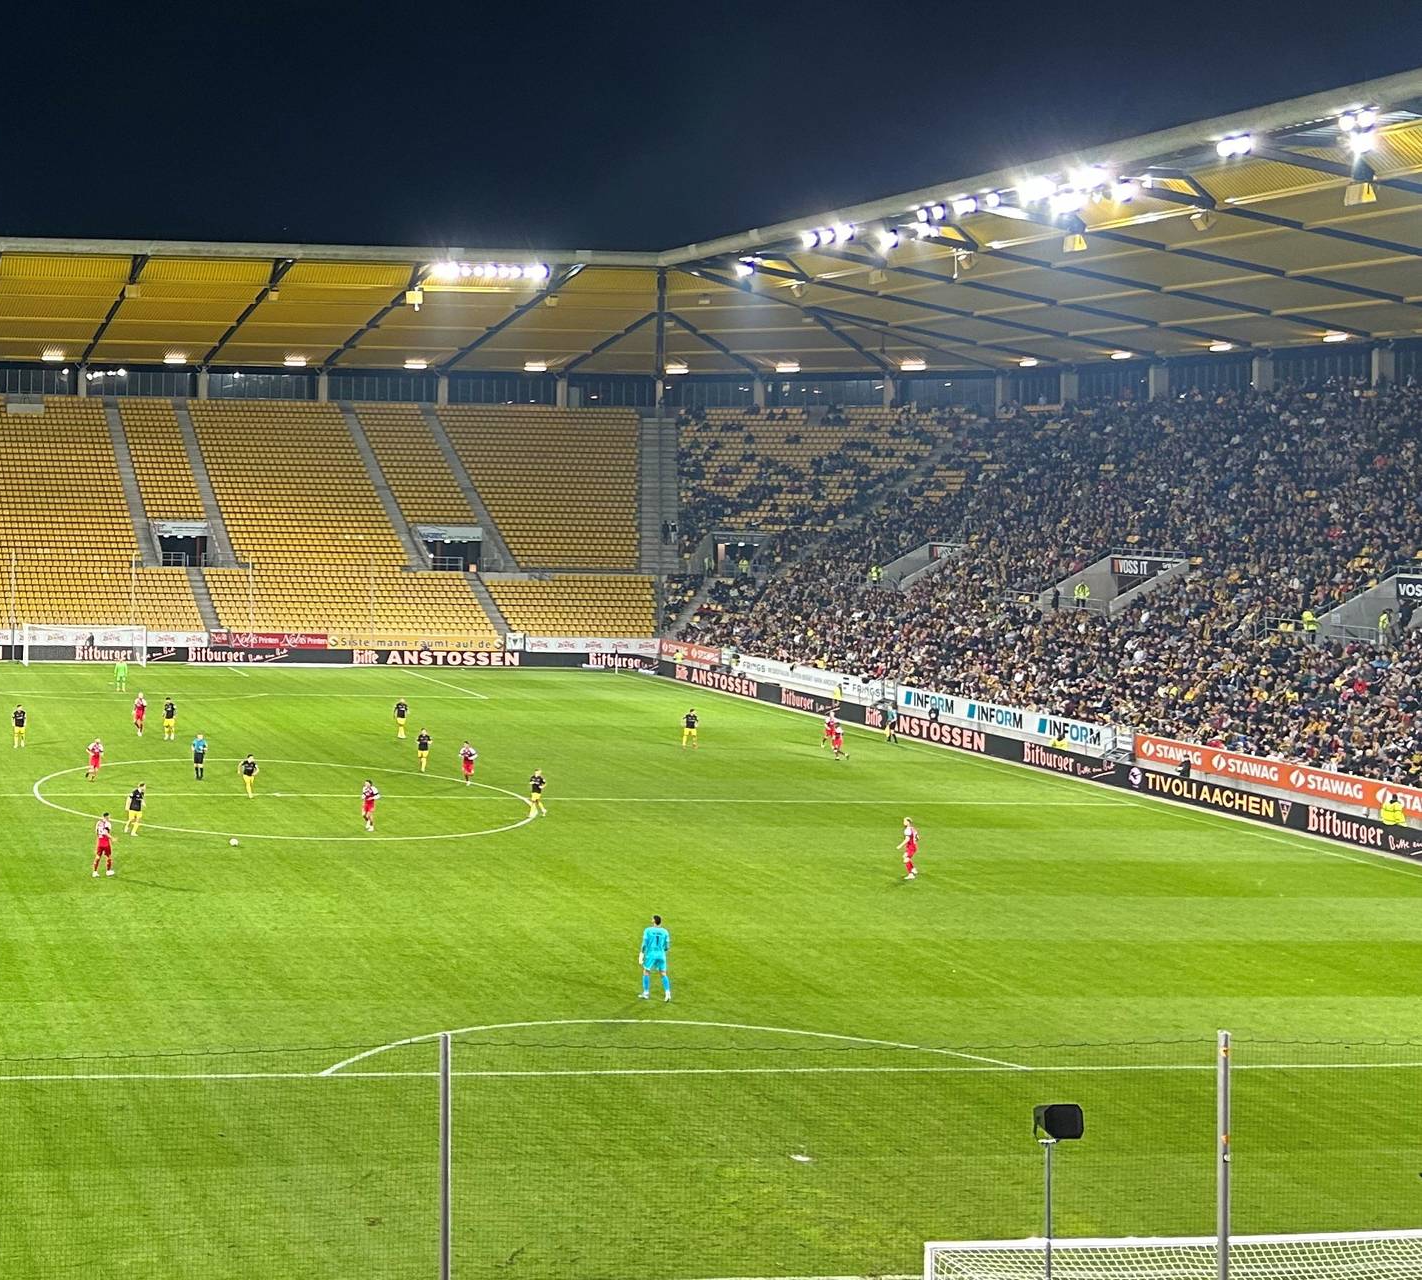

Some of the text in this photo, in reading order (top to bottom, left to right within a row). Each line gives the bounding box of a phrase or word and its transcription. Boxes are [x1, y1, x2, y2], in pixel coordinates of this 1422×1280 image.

[1119, 559, 1138, 575] VOSS
[1139, 561, 1148, 575] IT
[75, 645, 133, 661] Bitburger
[187, 647, 244, 662] Bitburger
[353, 649, 520, 666] Bitte ANSTOSSEN
[691, 669, 757, 698] ANSTOSSEN
[781, 687, 814, 710] Bitburger
[914, 692, 954, 715] INFORM
[978, 705, 1023, 730] INFORM
[895, 714, 986, 752] NSTOSSEN
[1049, 719, 1101, 747] INFORM
[1023, 741, 1074, 772] Bitburger
[1228, 758, 1278, 782] STAWAG
[1145, 772, 1274, 818] TIVOLI AACHEN
[1307, 774, 1364, 800] STAWAG
[1307, 805, 1384, 846] Bitburger
